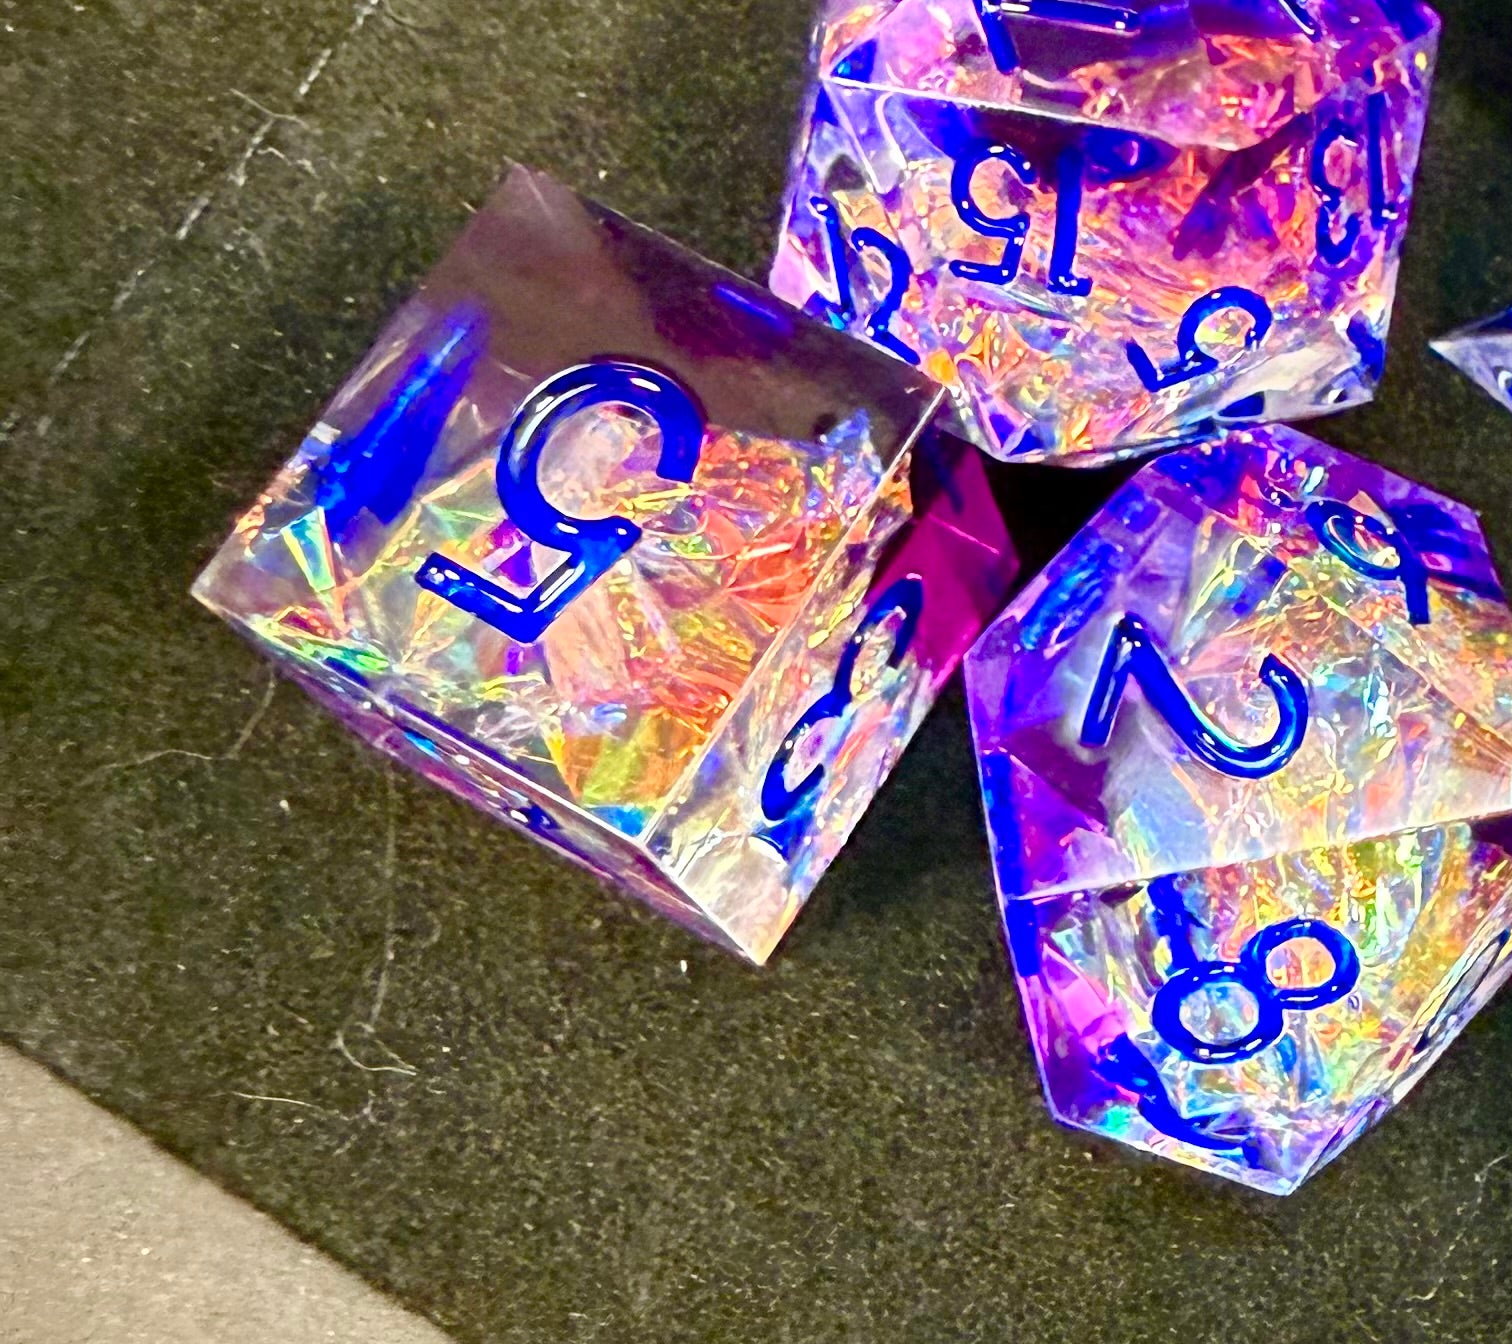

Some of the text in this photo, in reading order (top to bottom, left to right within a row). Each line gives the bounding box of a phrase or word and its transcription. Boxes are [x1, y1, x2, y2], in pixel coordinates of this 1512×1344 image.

[949, 139, 1092, 296] 15
[1126, 286, 1273, 392] 5
[415, 358, 708, 642] 5
[762, 573, 924, 823] 3
[1081, 611, 1309, 780] 2
[1151, 916, 1361, 1064] 8
